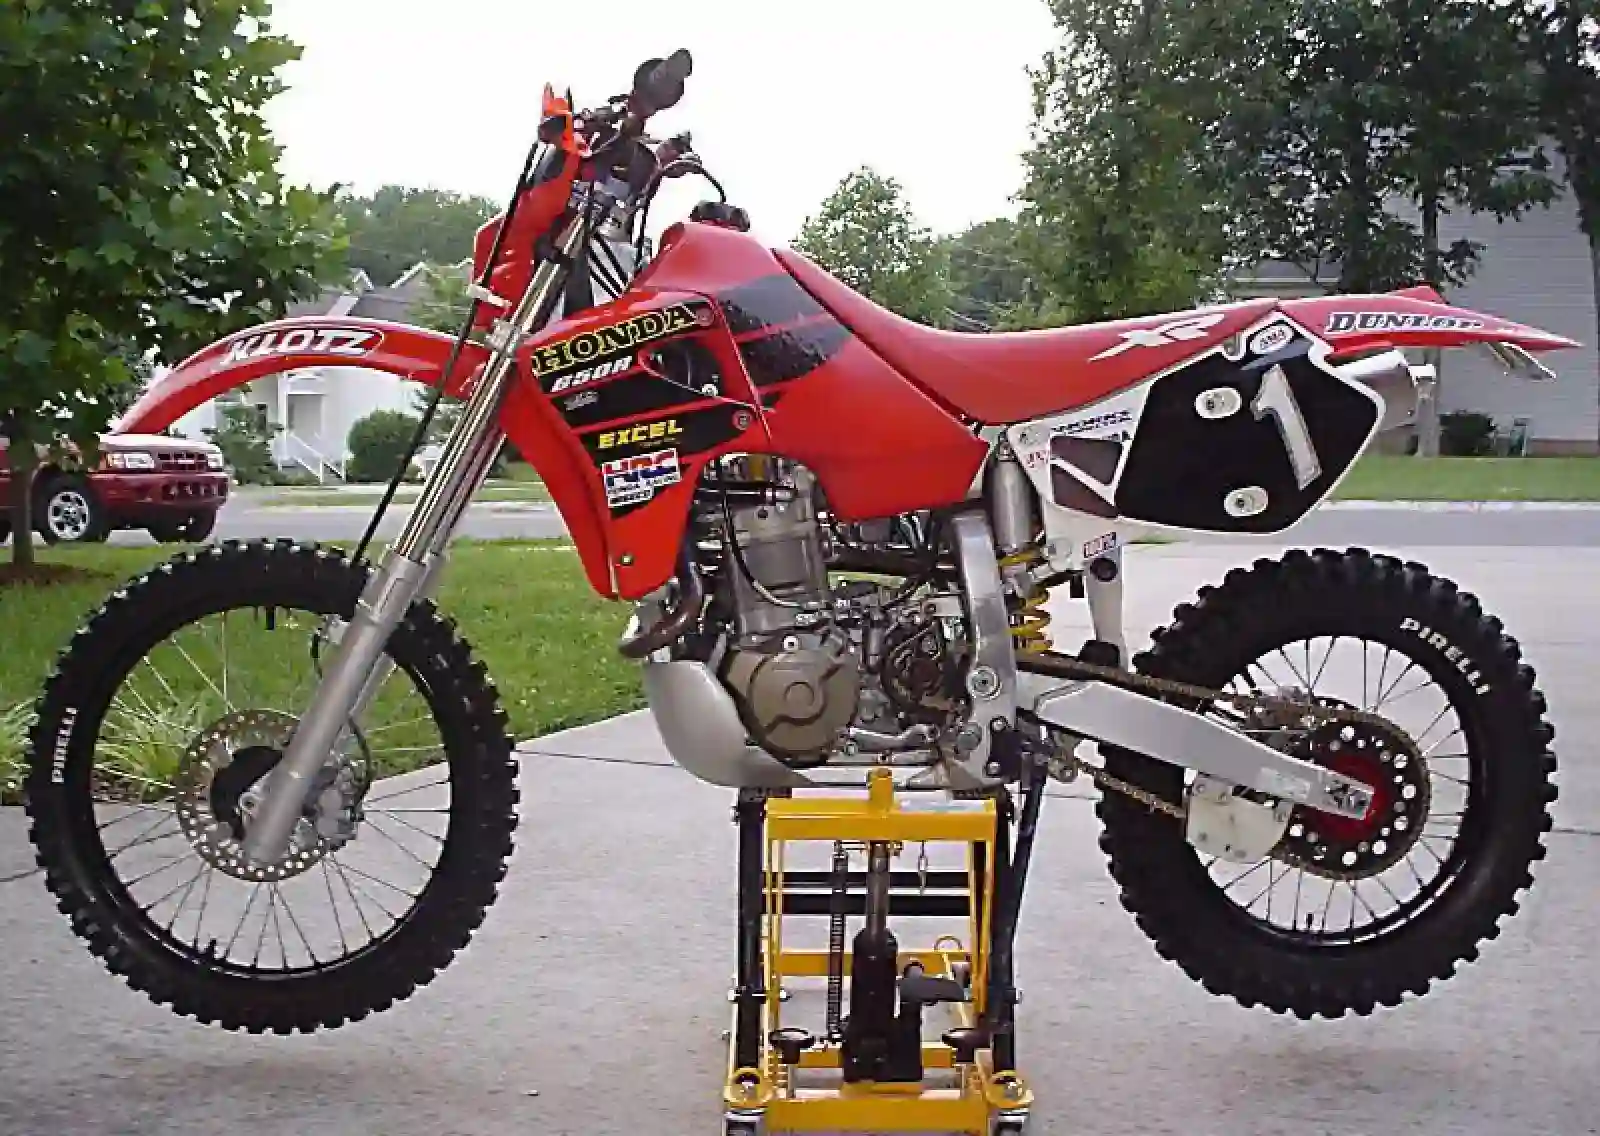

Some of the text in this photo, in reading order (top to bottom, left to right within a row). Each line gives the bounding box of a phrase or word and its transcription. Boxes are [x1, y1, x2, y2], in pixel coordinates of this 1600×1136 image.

[220, 328, 376, 365] KLOTZ
[532, 302, 697, 377] HONDA
[1088, 313, 1225, 362] XR
[1324, 311, 1485, 334] DUNLOP
[598, 420, 684, 448] EXCEL
[1251, 364, 1323, 489] 1
[604, 450, 677, 488] HRC
[1400, 617, 1491, 695] PIRELLI
[51, 707, 78, 783] PIRELLI
